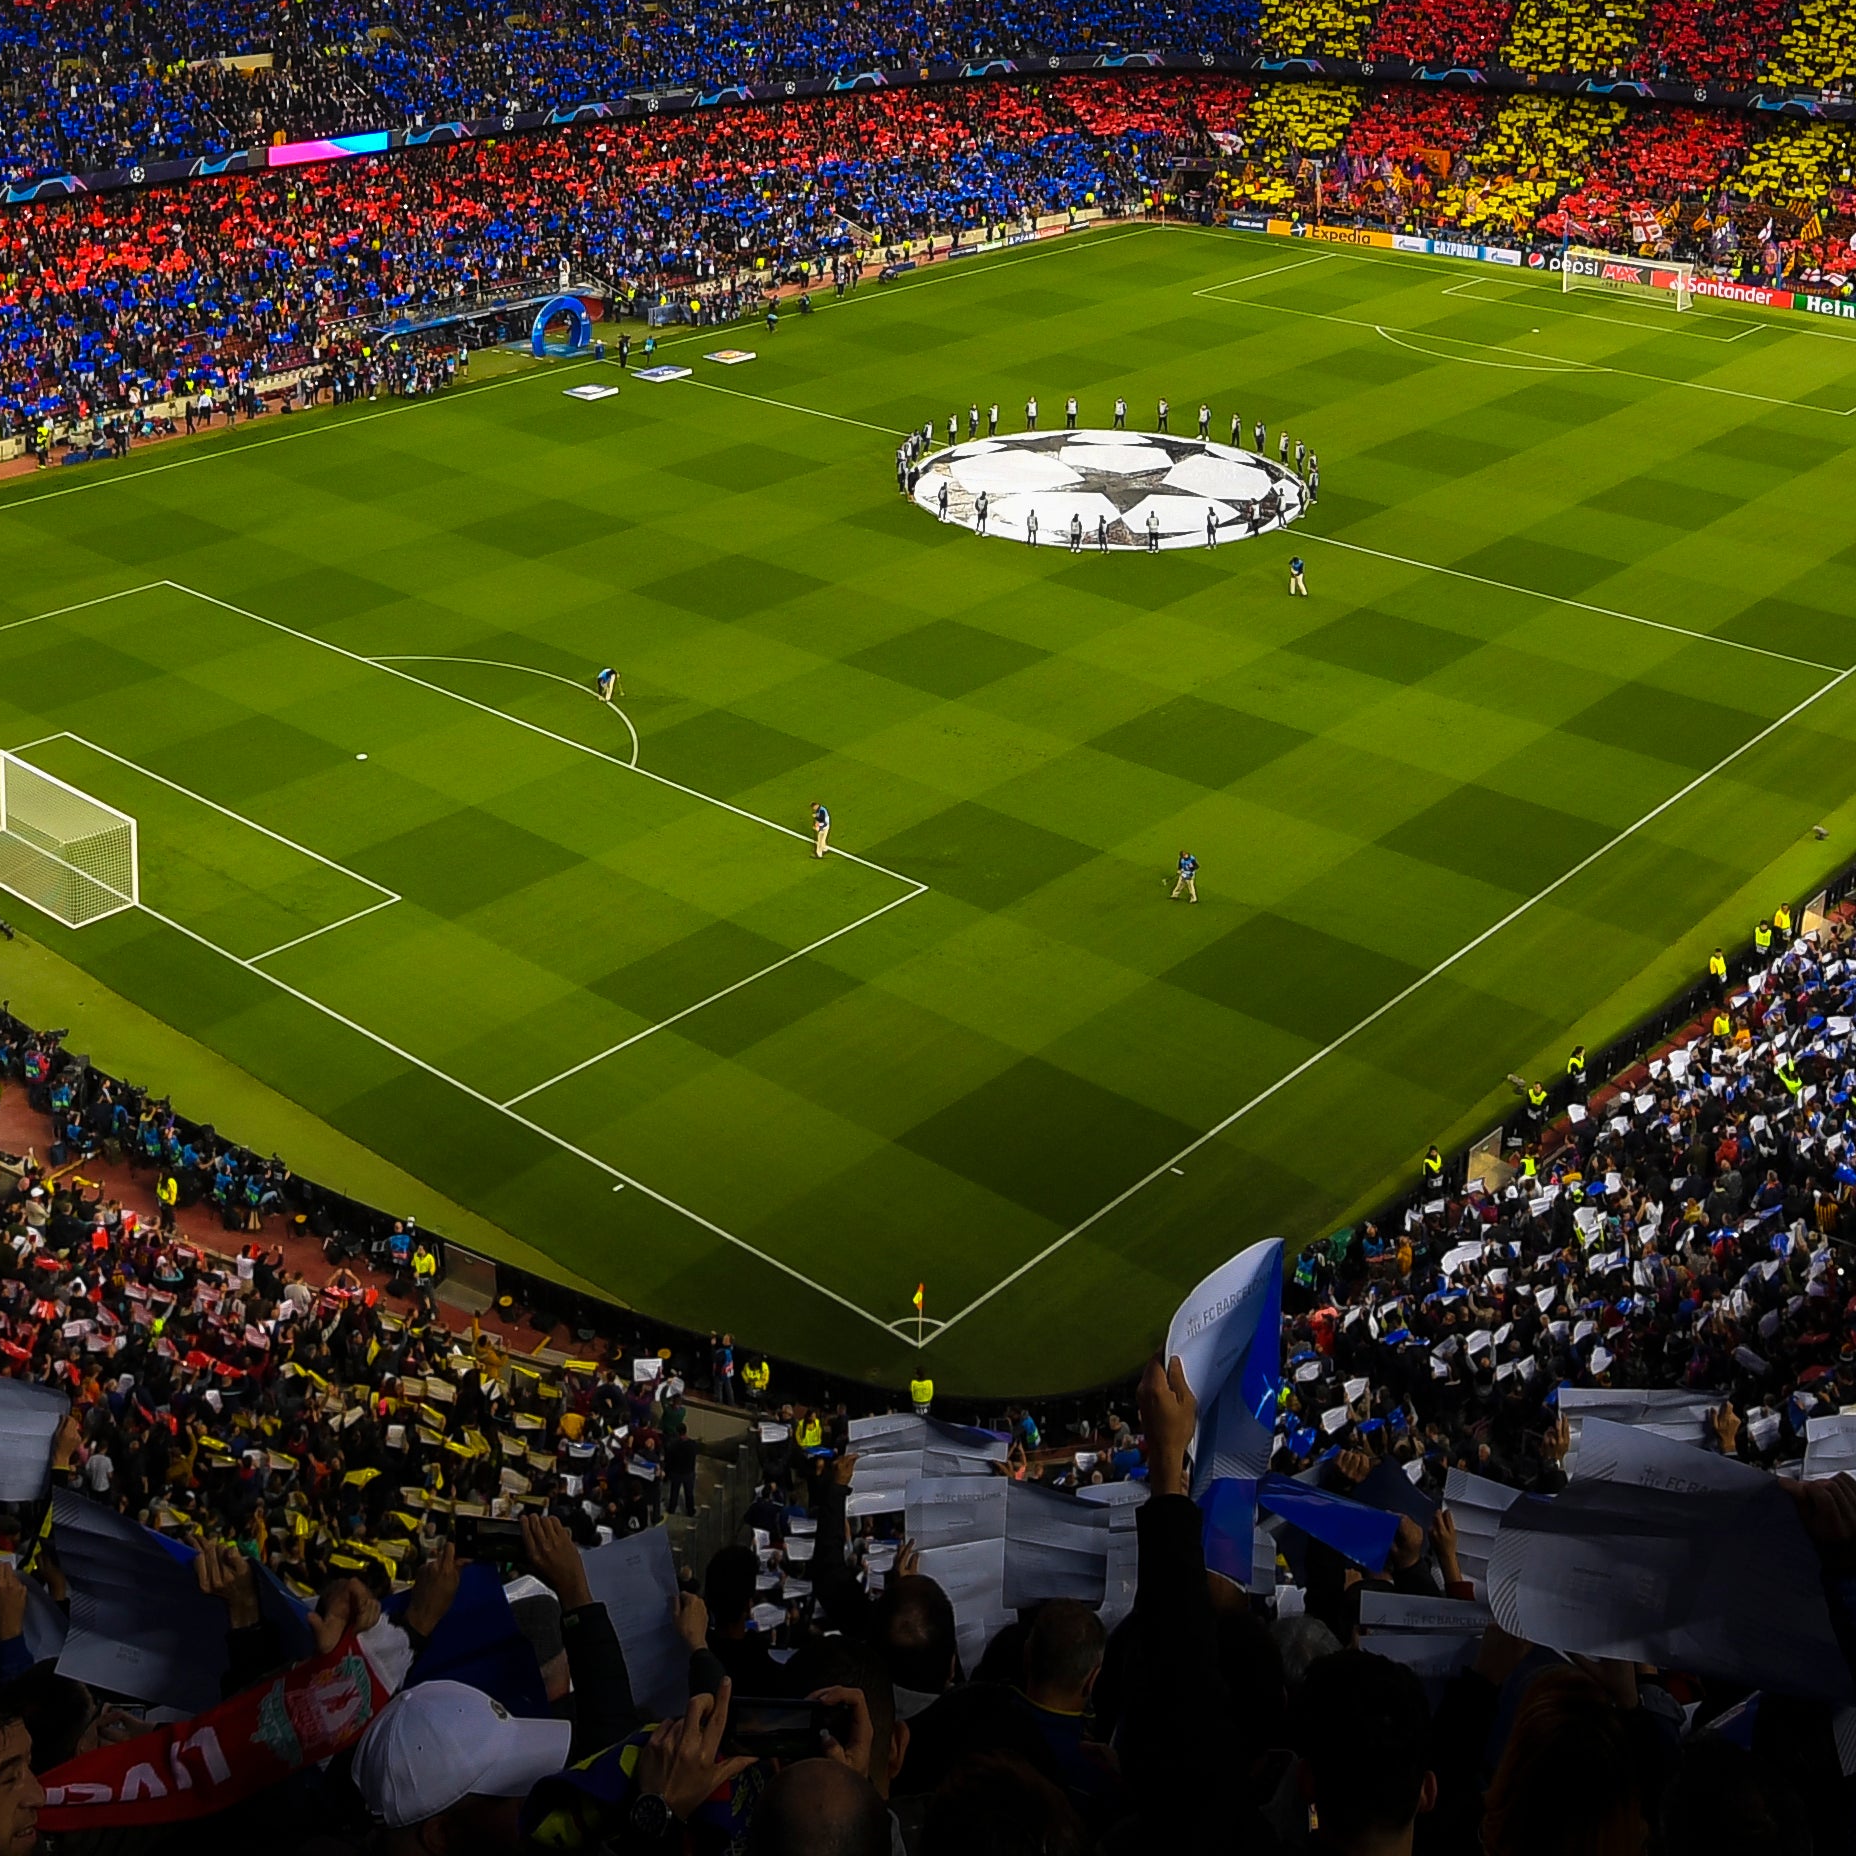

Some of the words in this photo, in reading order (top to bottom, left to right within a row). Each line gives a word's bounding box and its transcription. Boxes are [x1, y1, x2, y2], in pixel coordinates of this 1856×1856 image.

[1311, 225, 1371, 246] Expedia
[1433, 240, 1479, 259] GAZPROM
[1549, 256, 1599, 278] pepsi
[1687, 276, 1774, 306] Santander
[1202, 1306, 1216, 1326] FC
[1665, 1476, 1686, 1491] FC
